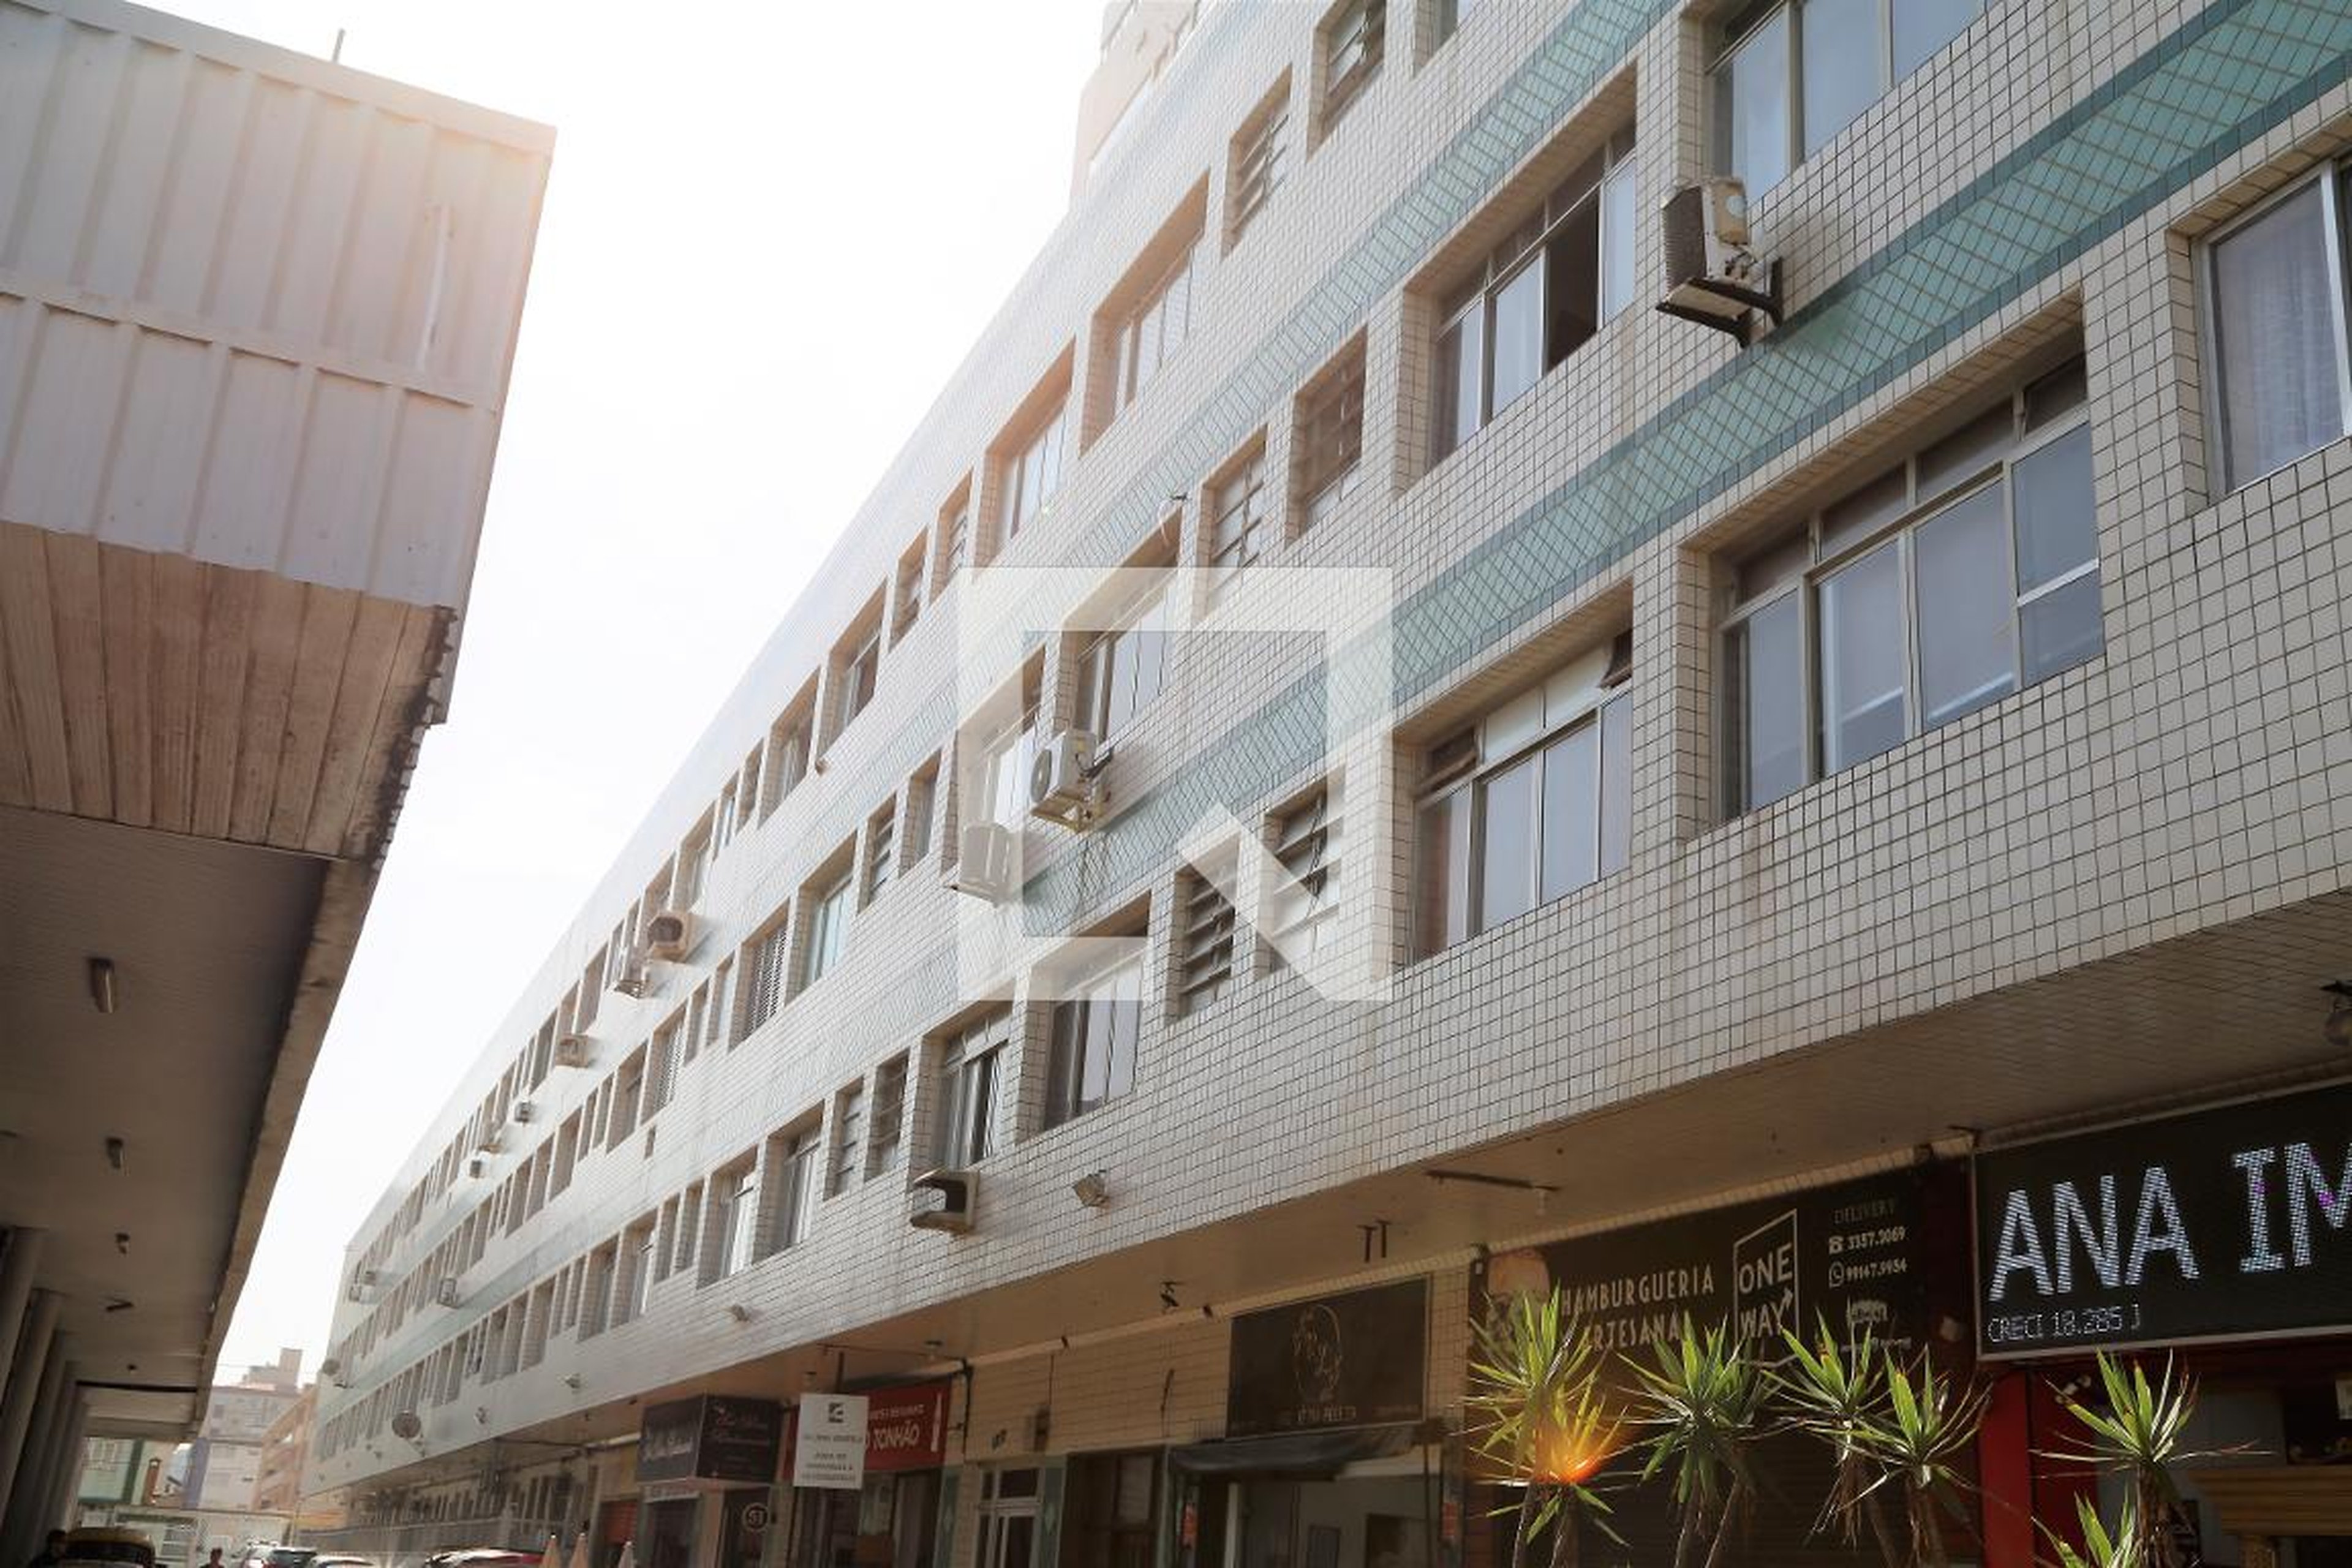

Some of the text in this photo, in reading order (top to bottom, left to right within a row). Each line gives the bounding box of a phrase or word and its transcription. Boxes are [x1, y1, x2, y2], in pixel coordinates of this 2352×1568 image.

[1988, 1166, 2199, 1302] ANA
[1561, 1264, 1714, 1316] HAMBURGUERIA
[1739, 1242, 1793, 1294] ONE
[1740, 1294, 1790, 1338] WAY
[1988, 1313, 2044, 1342] CRECI
